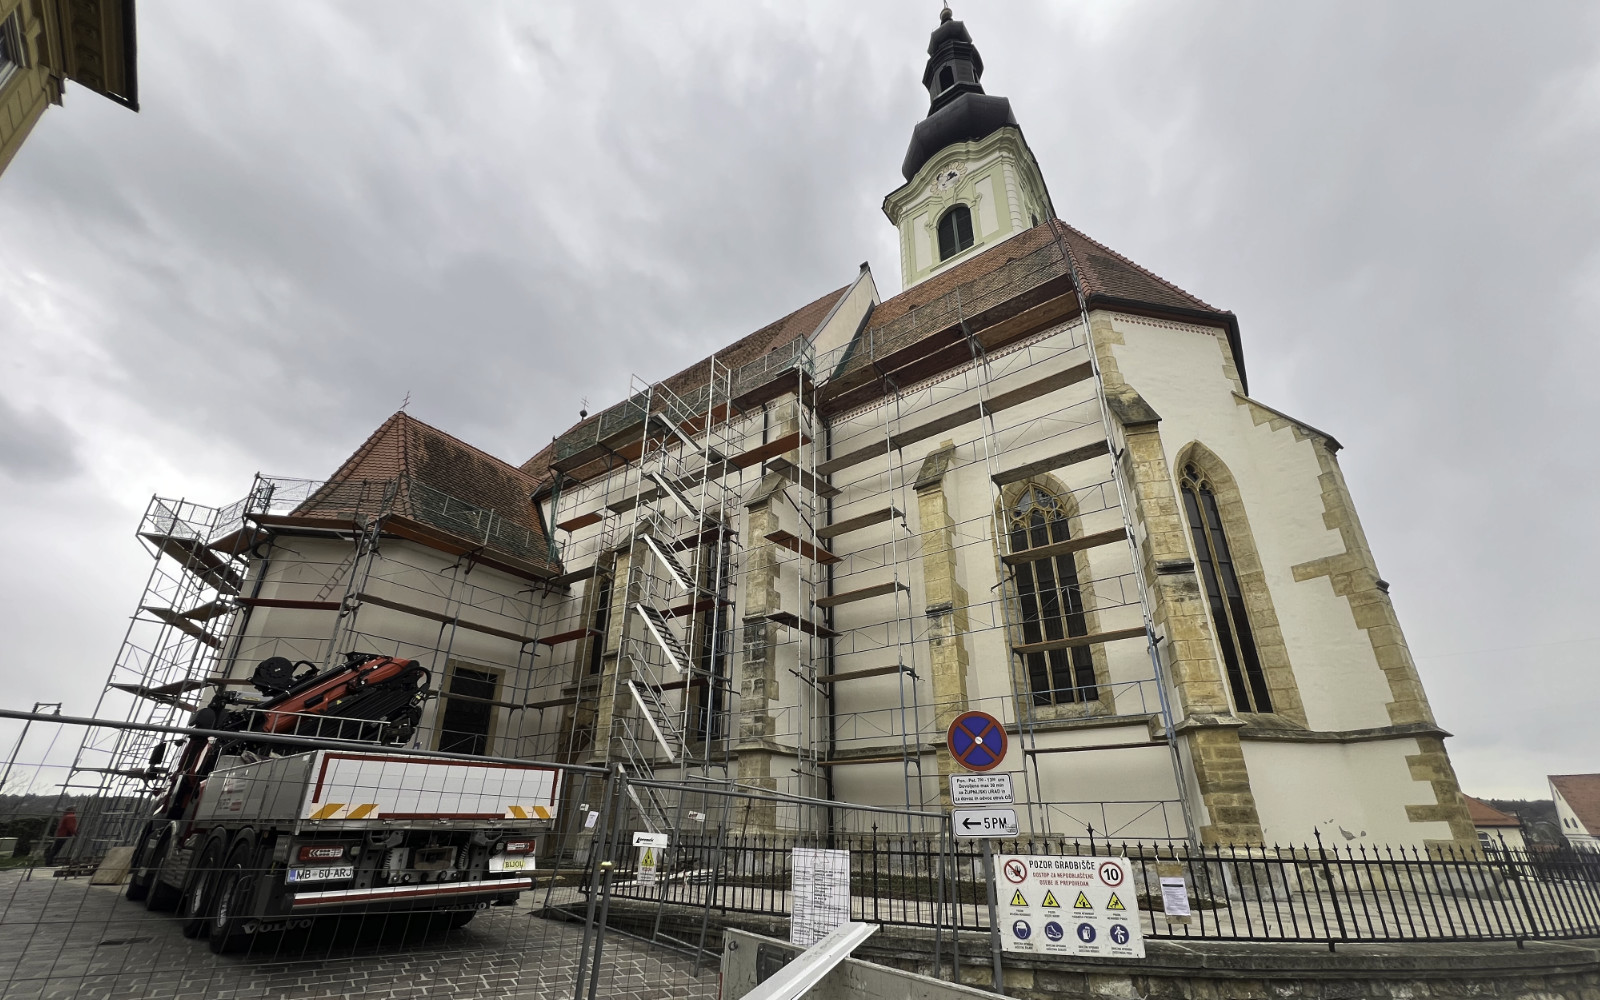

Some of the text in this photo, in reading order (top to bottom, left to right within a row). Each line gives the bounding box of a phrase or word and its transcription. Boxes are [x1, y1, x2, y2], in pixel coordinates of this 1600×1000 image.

[1028, 860, 1096, 870] POZOR GRADBIŠČE
[296, 869, 311, 880] MB
[1103, 868, 1119, 881] 10
[241, 918, 312, 935] VOLVO
